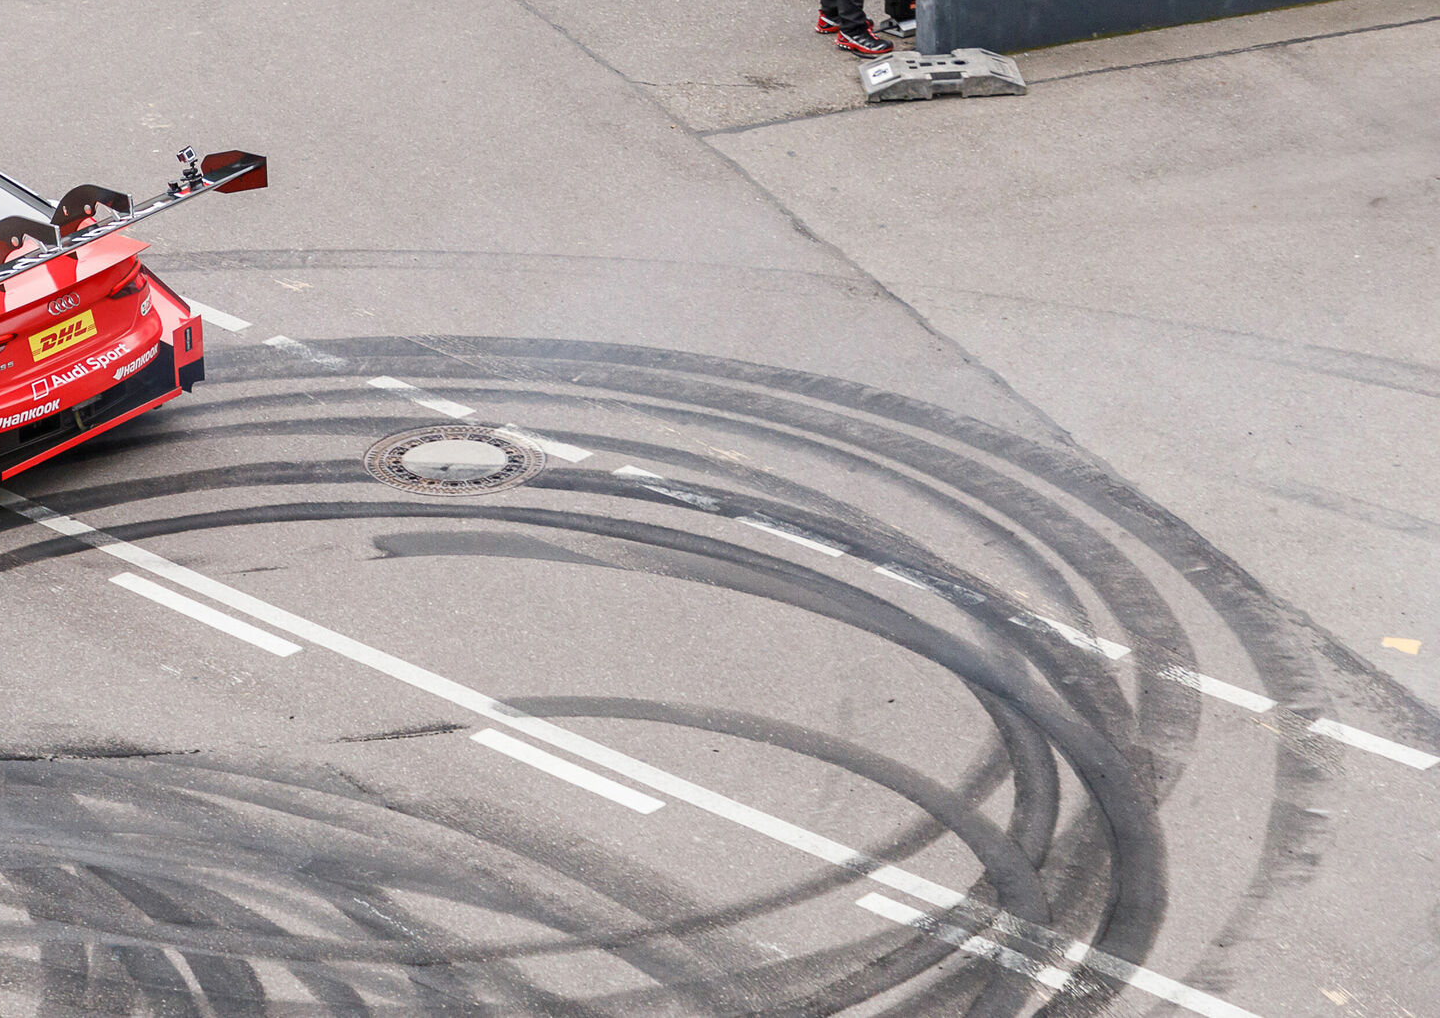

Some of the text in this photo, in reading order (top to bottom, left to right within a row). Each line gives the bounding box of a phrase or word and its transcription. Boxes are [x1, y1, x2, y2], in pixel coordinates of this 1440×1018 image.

[40, 319, 88, 354] DHL
[50, 343, 131, 389] Audi Sport
